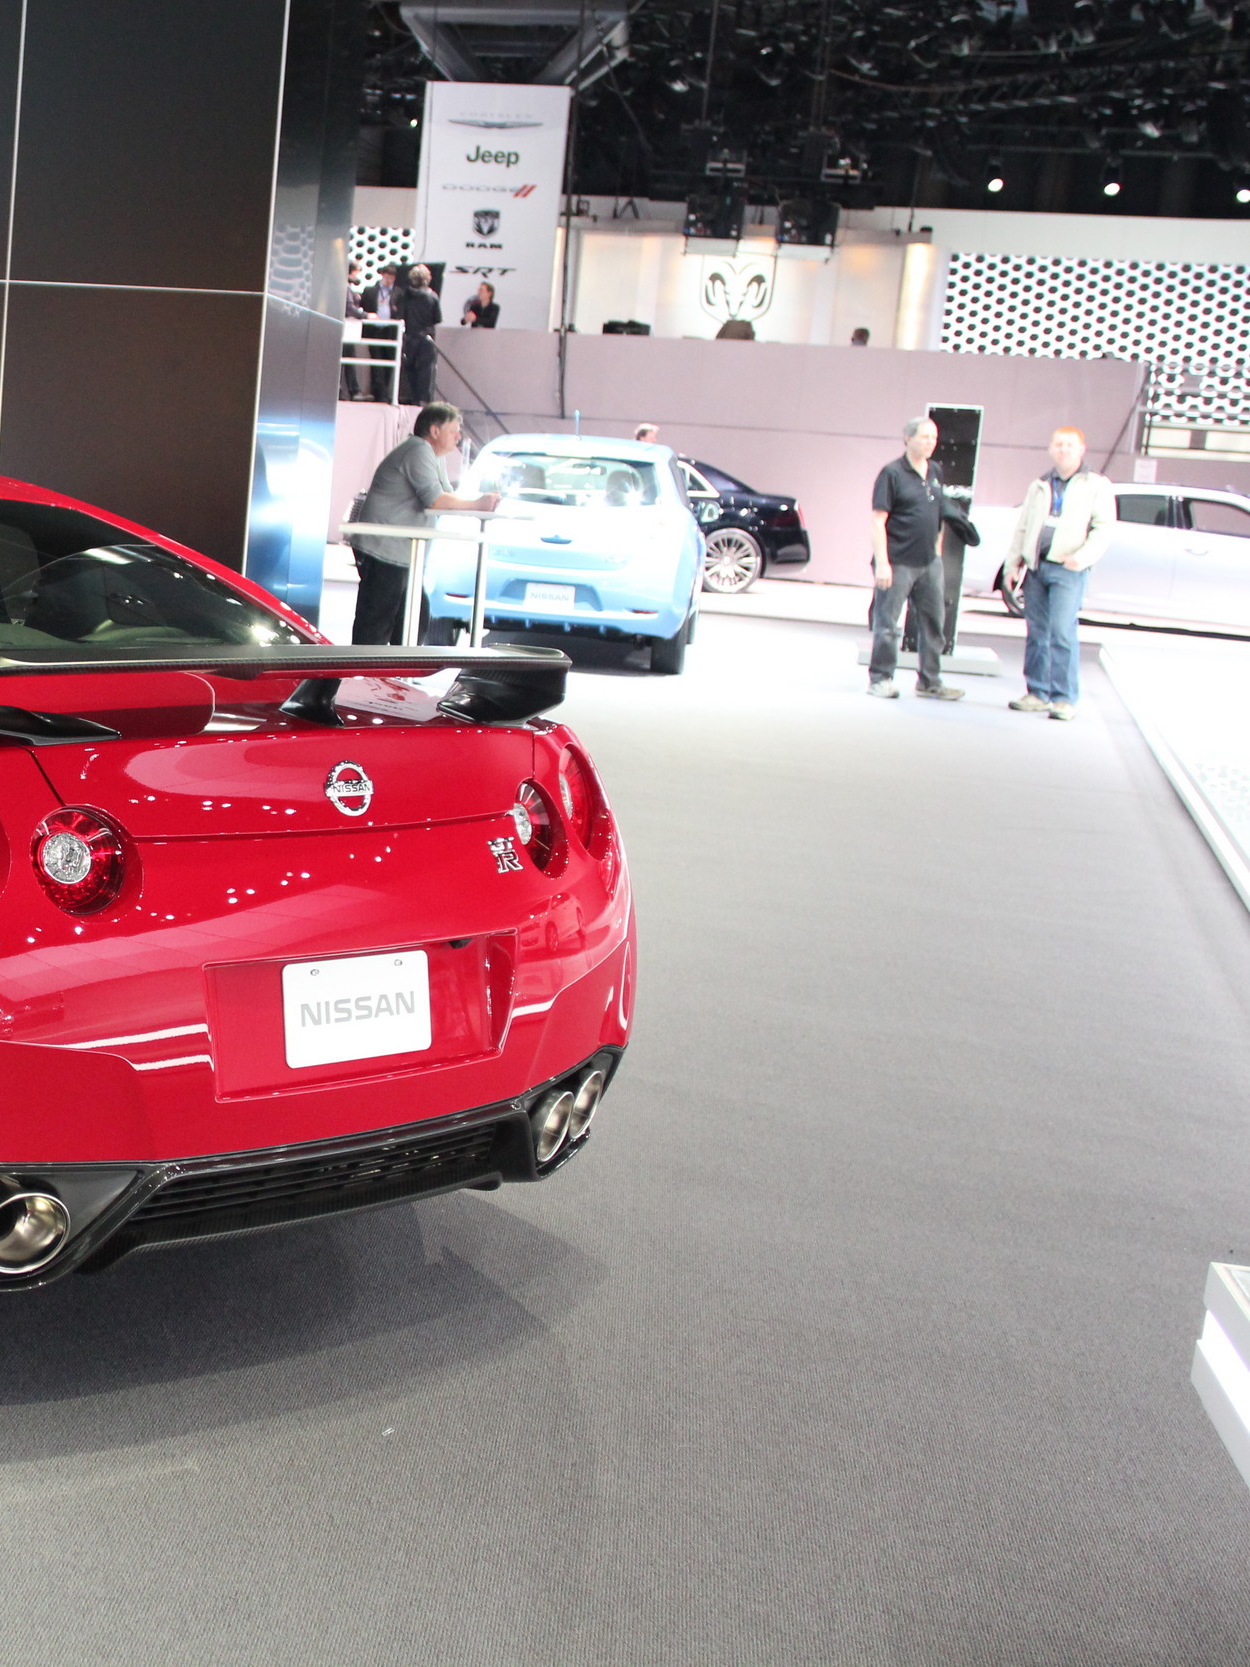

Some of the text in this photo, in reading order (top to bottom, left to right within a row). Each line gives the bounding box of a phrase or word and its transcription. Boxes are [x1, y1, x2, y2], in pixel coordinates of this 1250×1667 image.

[466, 145, 519, 168] Jeep
[465, 241, 503, 249] RAM
[449, 265, 518, 278] SRT
[529, 592, 570, 602] NISSAN
[332, 783, 371, 793] NISSAN
[300, 991, 416, 1028] NISSAN
